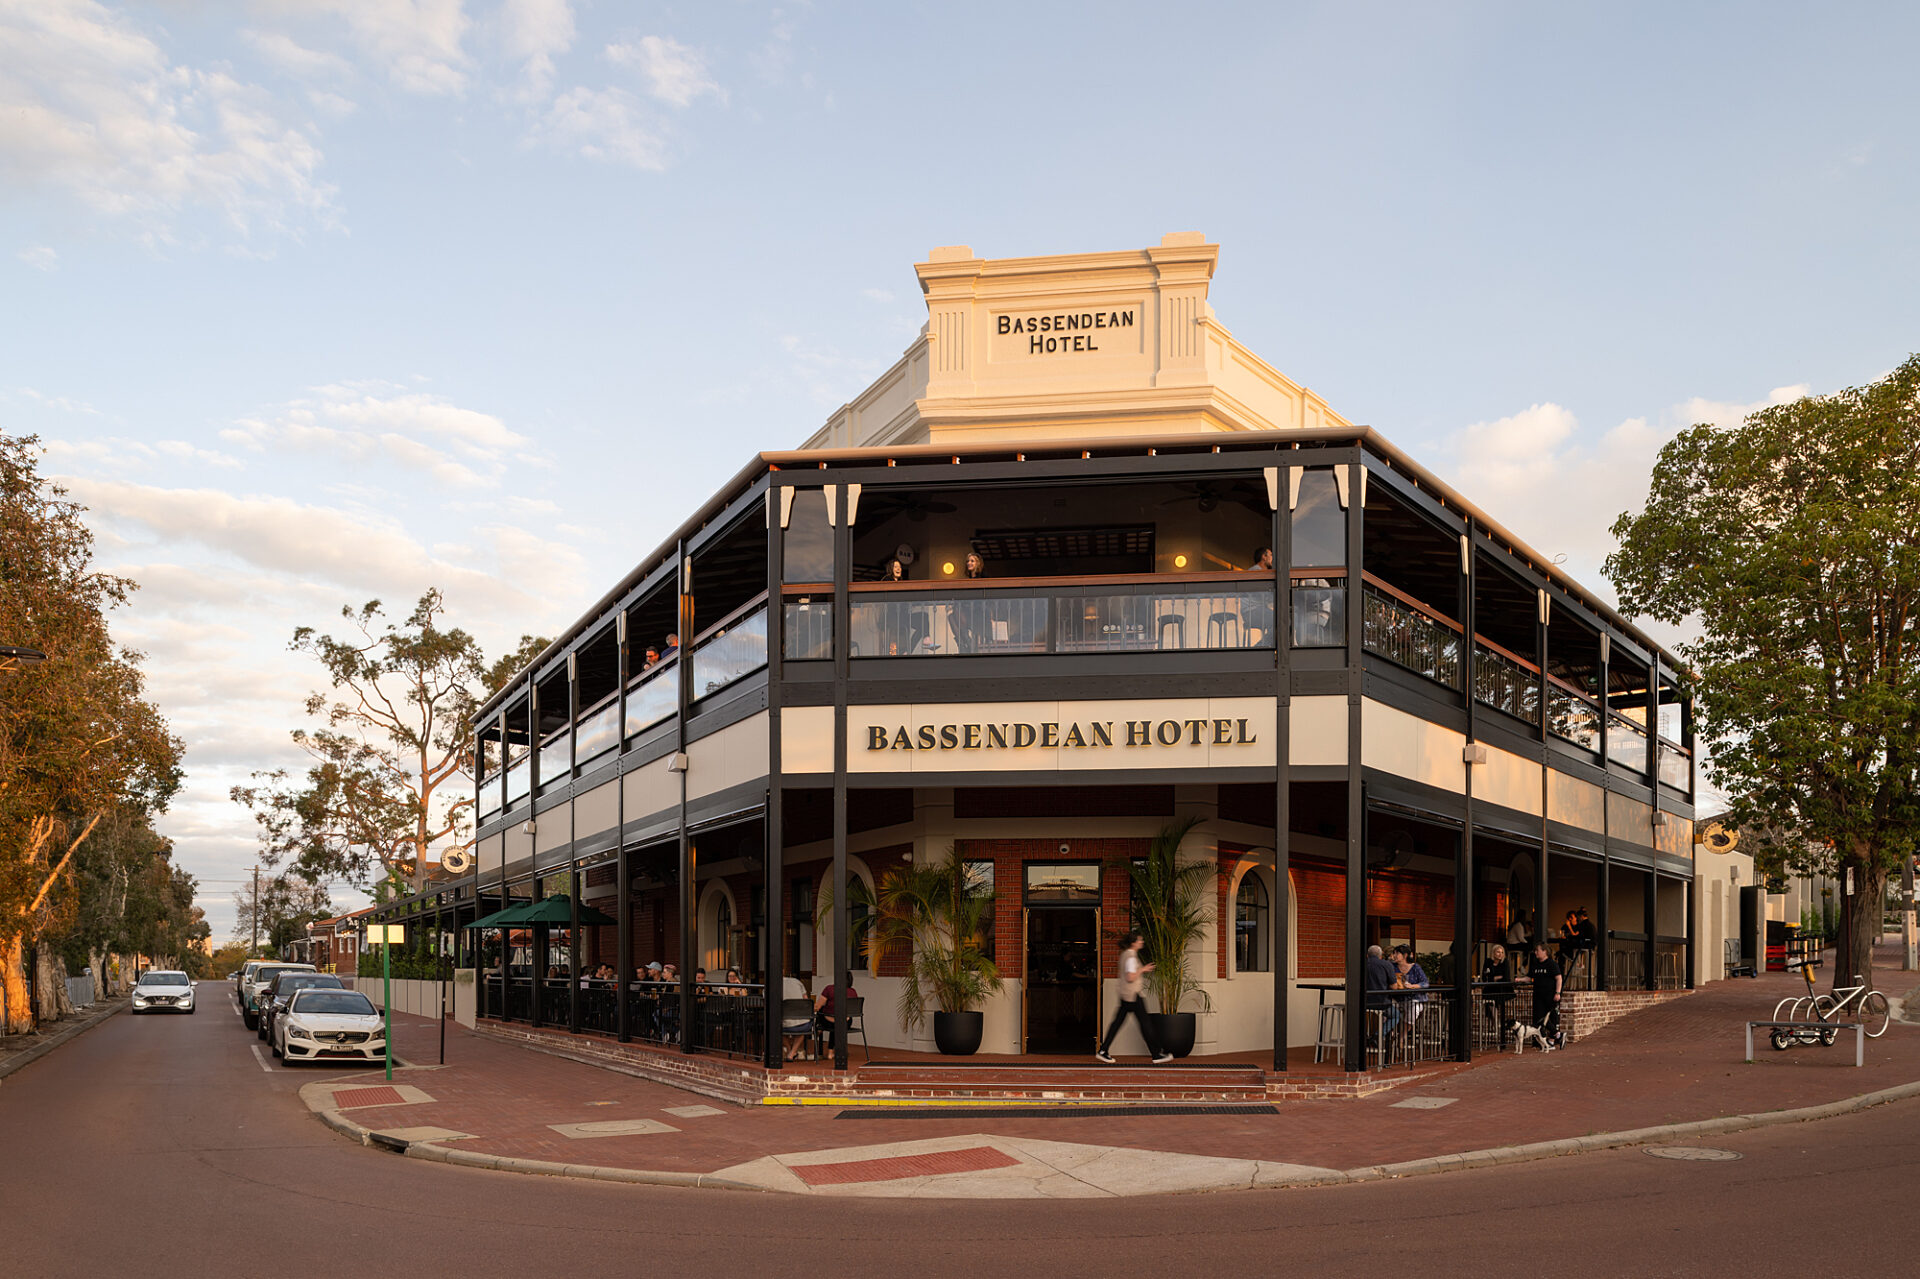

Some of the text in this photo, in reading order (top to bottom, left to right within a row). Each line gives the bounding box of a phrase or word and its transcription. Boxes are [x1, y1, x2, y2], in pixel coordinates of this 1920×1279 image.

[998, 311, 1134, 335] BASSENDEAN
[1030, 335, 1099, 354] HOTEL
[867, 718, 1258, 751] BASSENDEAN HOTEL
